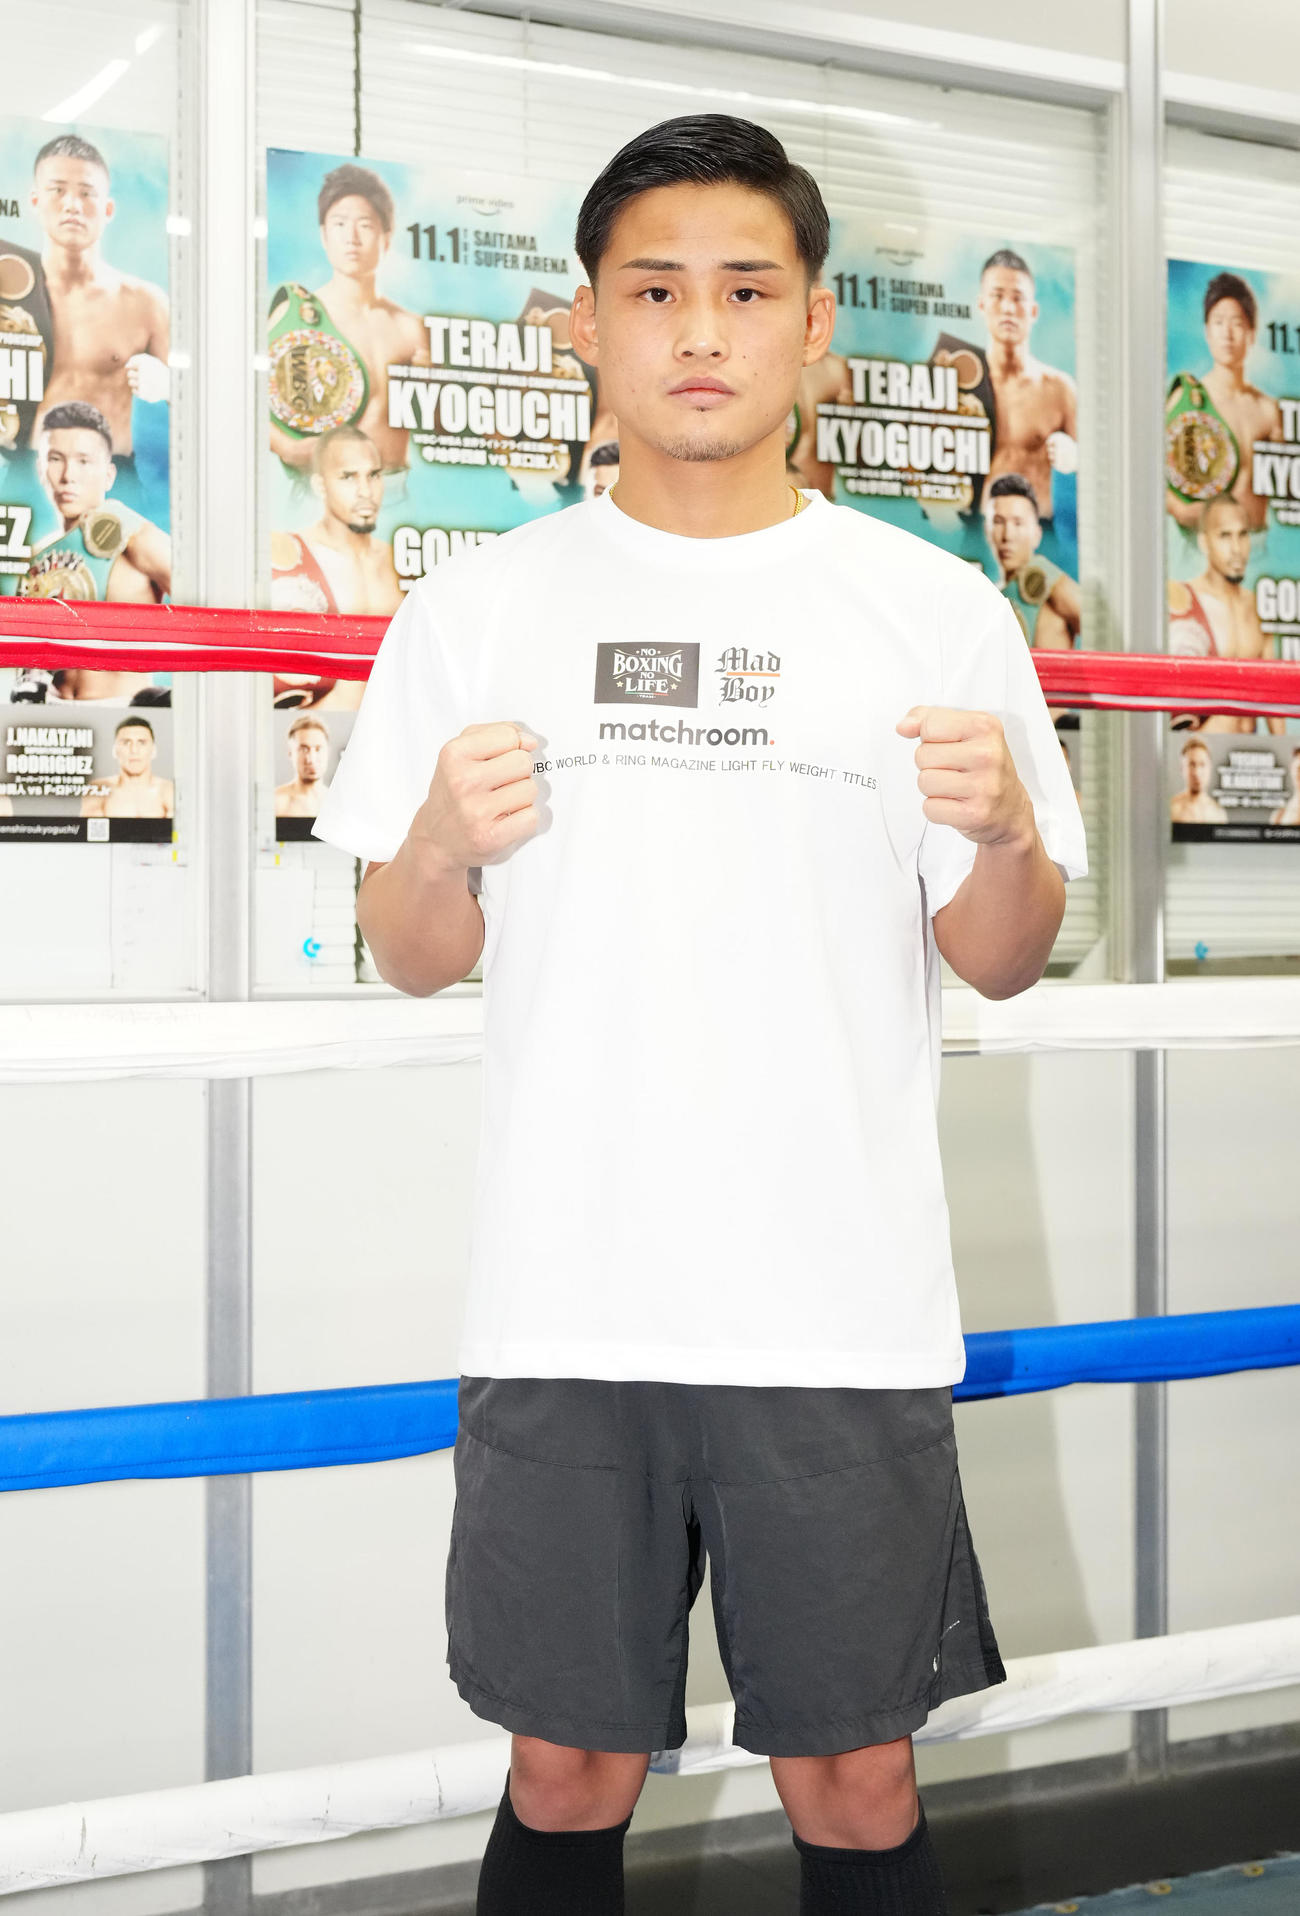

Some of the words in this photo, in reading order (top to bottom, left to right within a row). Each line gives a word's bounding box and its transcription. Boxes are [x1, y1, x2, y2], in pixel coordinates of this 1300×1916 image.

[407, 223, 459, 263] 11.1
[473, 229, 537, 252] SAITAMA
[474, 250, 519, 269] SUPER
[523, 254, 568, 274] ARENA
[832, 272, 878, 309] 11.1
[890, 278, 944, 298] SAITAMA
[891, 297, 929, 316] SUPER
[933, 301, 971, 319] ARENA
[424, 316, 552, 373] TERAJI
[848, 358, 958, 412] TERAJI
[388, 379, 590, 441] KYOGUCHI
[817, 416, 990, 475] KYOGUCHI
[1257, 577, 1300, 622] GO
[613, 652, 683, 678] BOXING
[641, 648, 656, 656] NO
[714, 647, 781, 673] Mad
[625, 677, 669, 693] LIFE
[640, 671, 654, 679] NO
[719, 677, 775, 708] Boy
[600, 719, 775, 746] matchroom.
[556, 754, 597, 769] WORLD
[602, 754, 610, 765] &
[615, 755, 646, 766] RING
[651, 756, 716, 771] MAGAZINE
[721, 760, 757, 771] LIGHT
[762, 760, 785, 771] FLY
[790, 761, 837, 780] WEIGHT
[842, 771, 877, 790] TITLES
